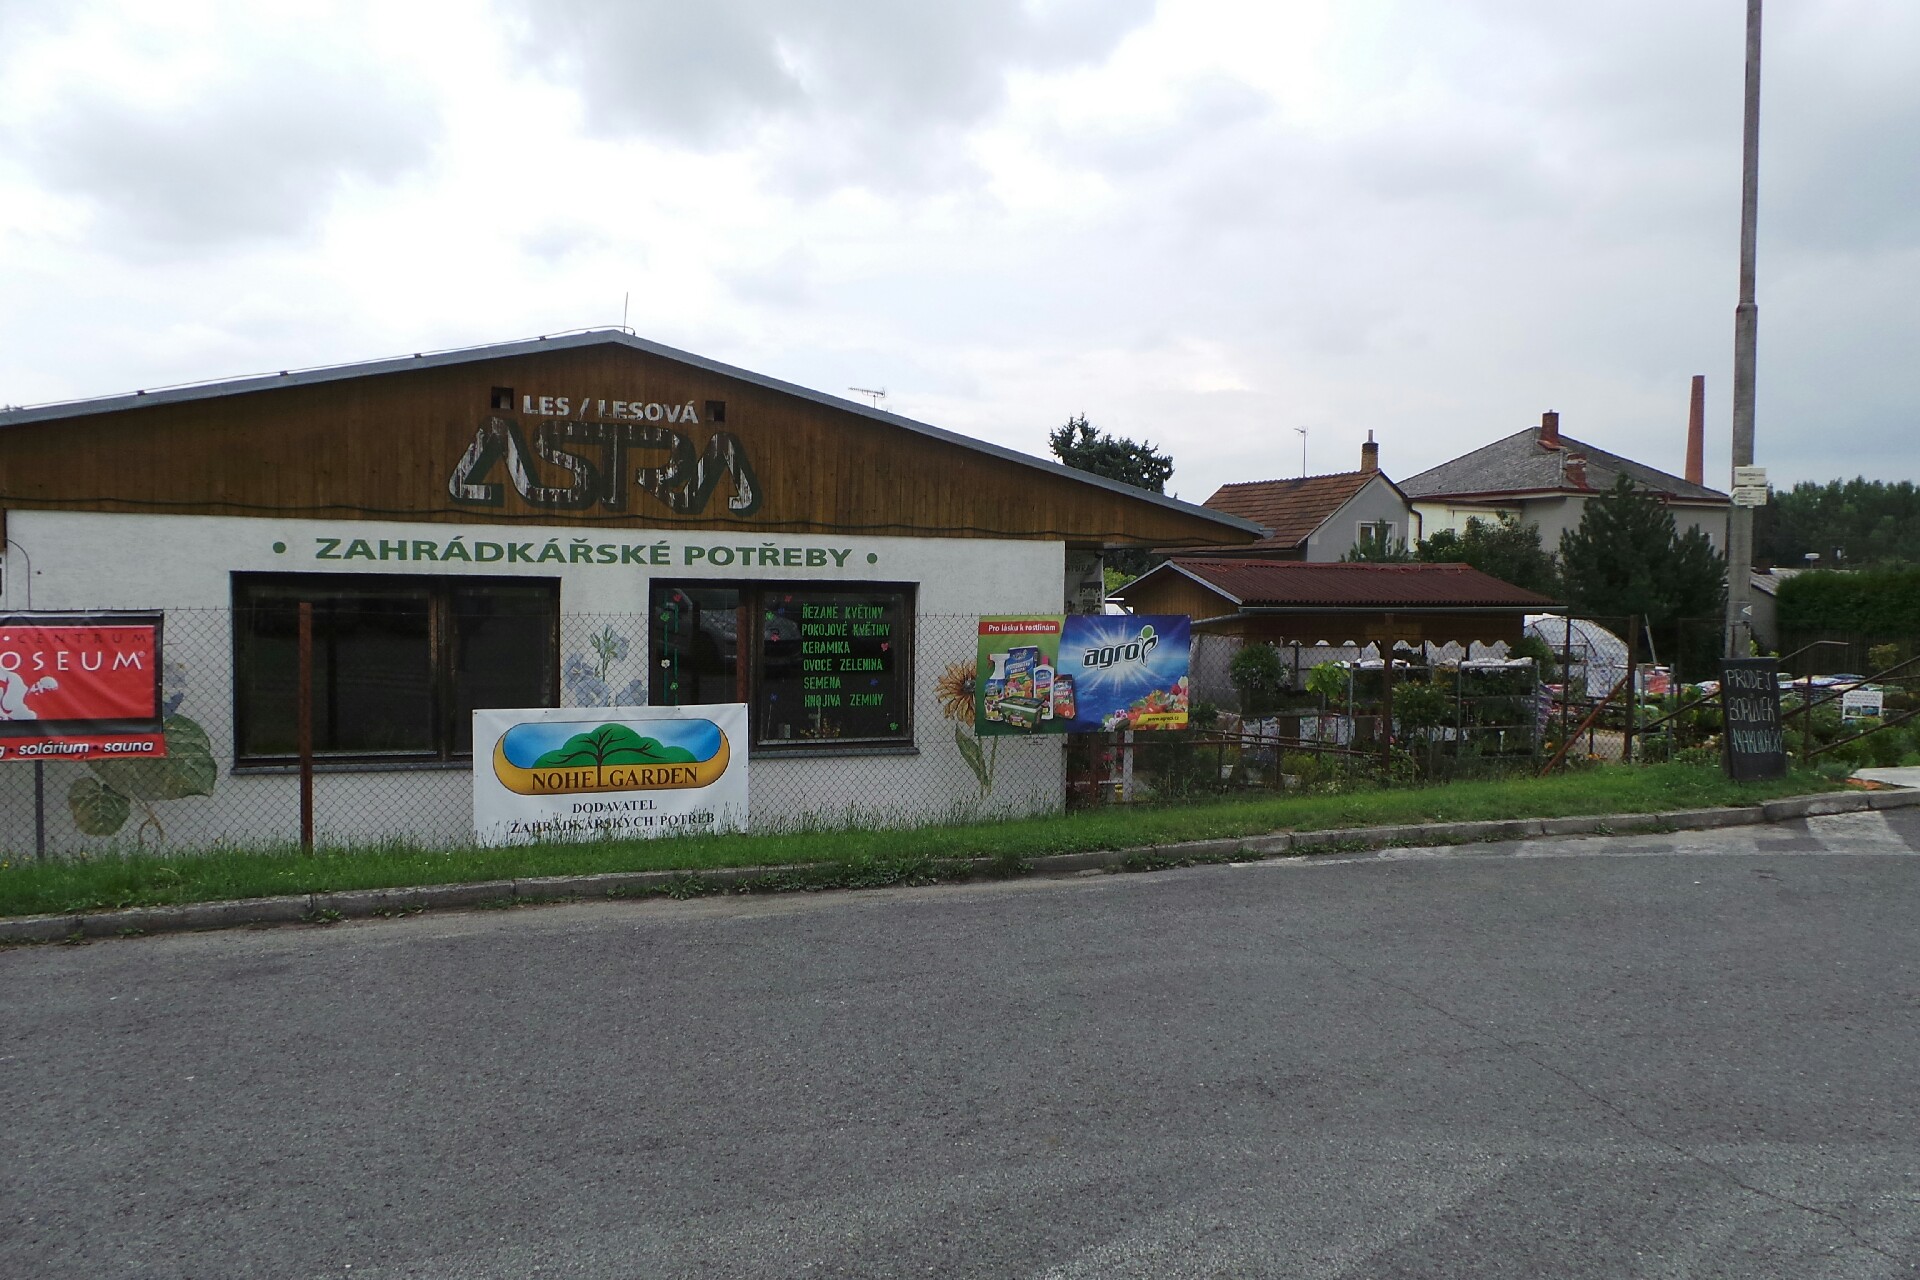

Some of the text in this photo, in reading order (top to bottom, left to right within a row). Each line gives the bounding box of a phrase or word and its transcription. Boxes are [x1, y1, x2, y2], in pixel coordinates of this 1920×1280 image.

[523, 395, 569, 416] LES
[598, 399, 699, 423] LESOVÁ
[315, 535, 852, 567] ZAHRÁDKÁŘSKÉ POTŘEBY
[845, 604, 884, 619] KVĚTINY
[988, 623, 1056, 632] Pro lásku k rostlinám
[17, 633, 147, 644] CENTRUM
[802, 641, 850, 654] KERAMIKA
[803, 658, 883, 671] OVOCE ZELENINA
[804, 676, 841, 689] SEMENA
[1725, 669, 1771, 690] PRODEJ
[804, 694, 884, 708] HNOJIVA ZEMINY
[19, 741, 89, 755] solárium
[104, 741, 153, 753] sauna
[531, 764, 698, 790] NOHEL GARDEN
[572, 799, 657, 814] DODAVATEL
